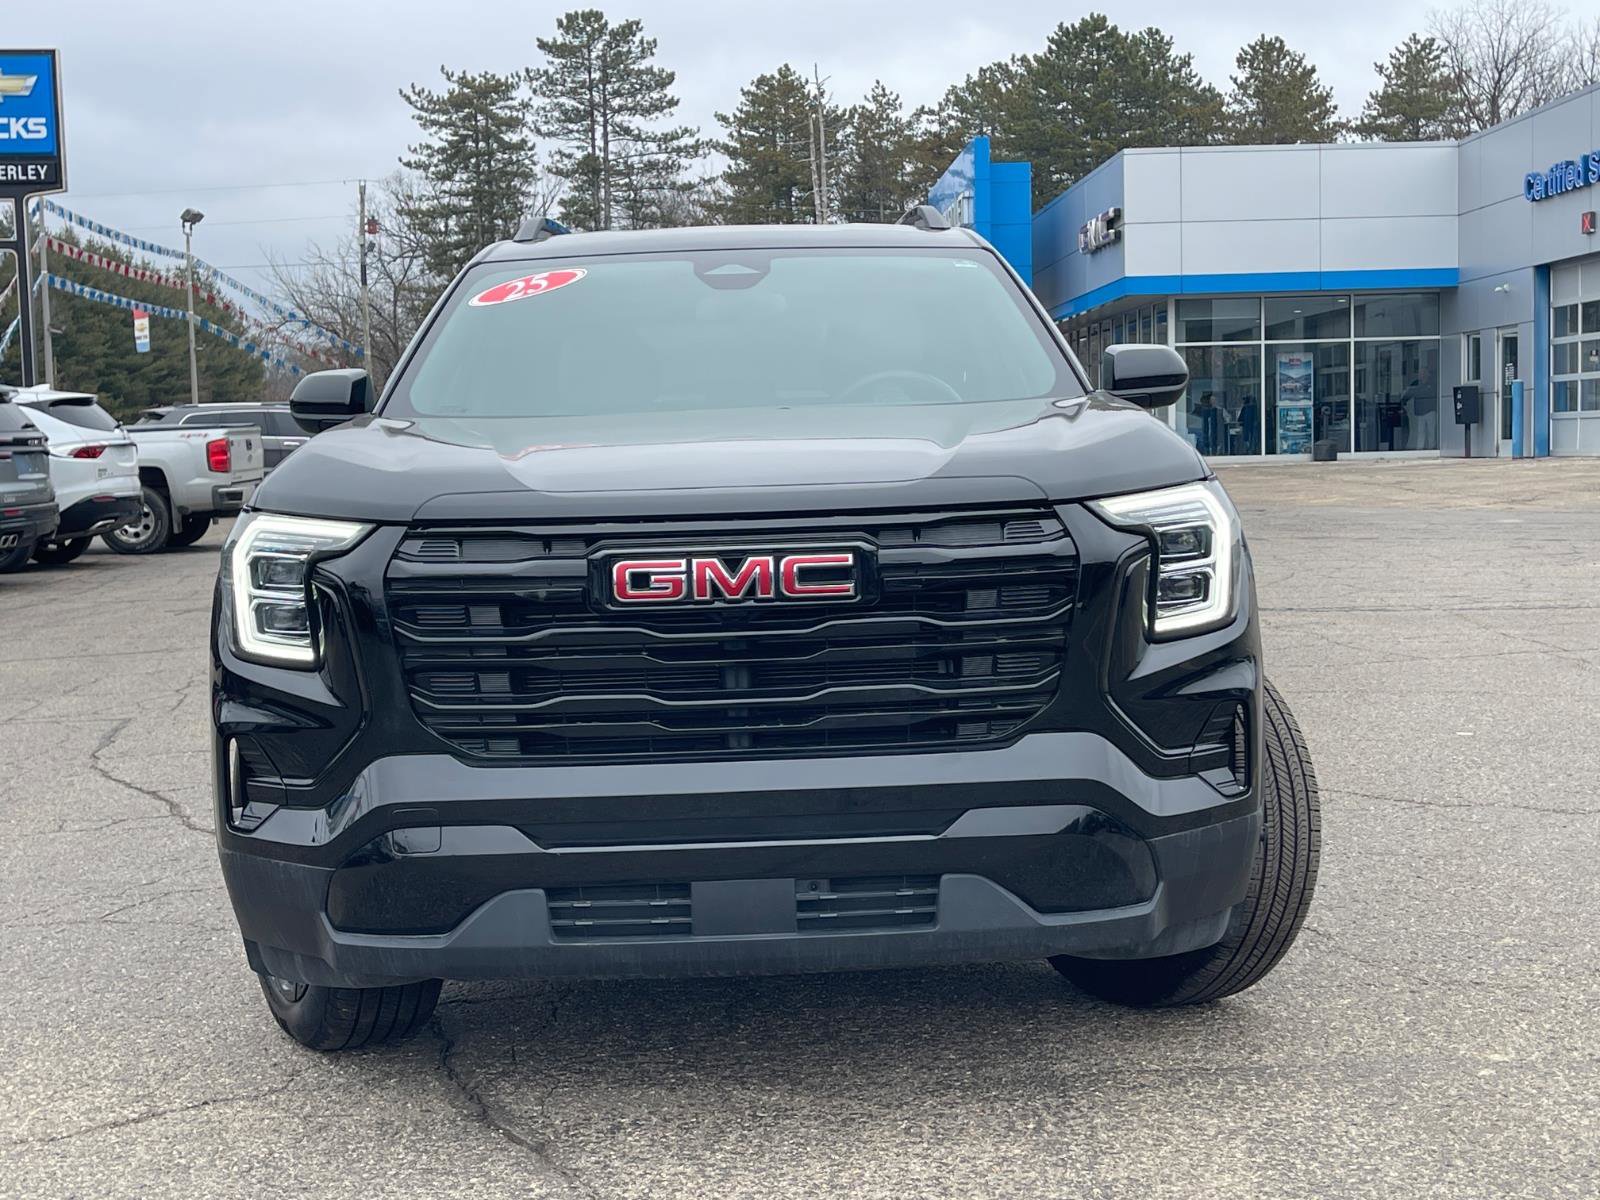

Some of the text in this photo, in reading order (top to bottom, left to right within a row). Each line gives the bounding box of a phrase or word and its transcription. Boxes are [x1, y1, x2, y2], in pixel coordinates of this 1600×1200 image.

[1523, 153, 1588, 201] Certified
[503, 272, 550, 301] 25
[612, 553, 856, 602] GMC
